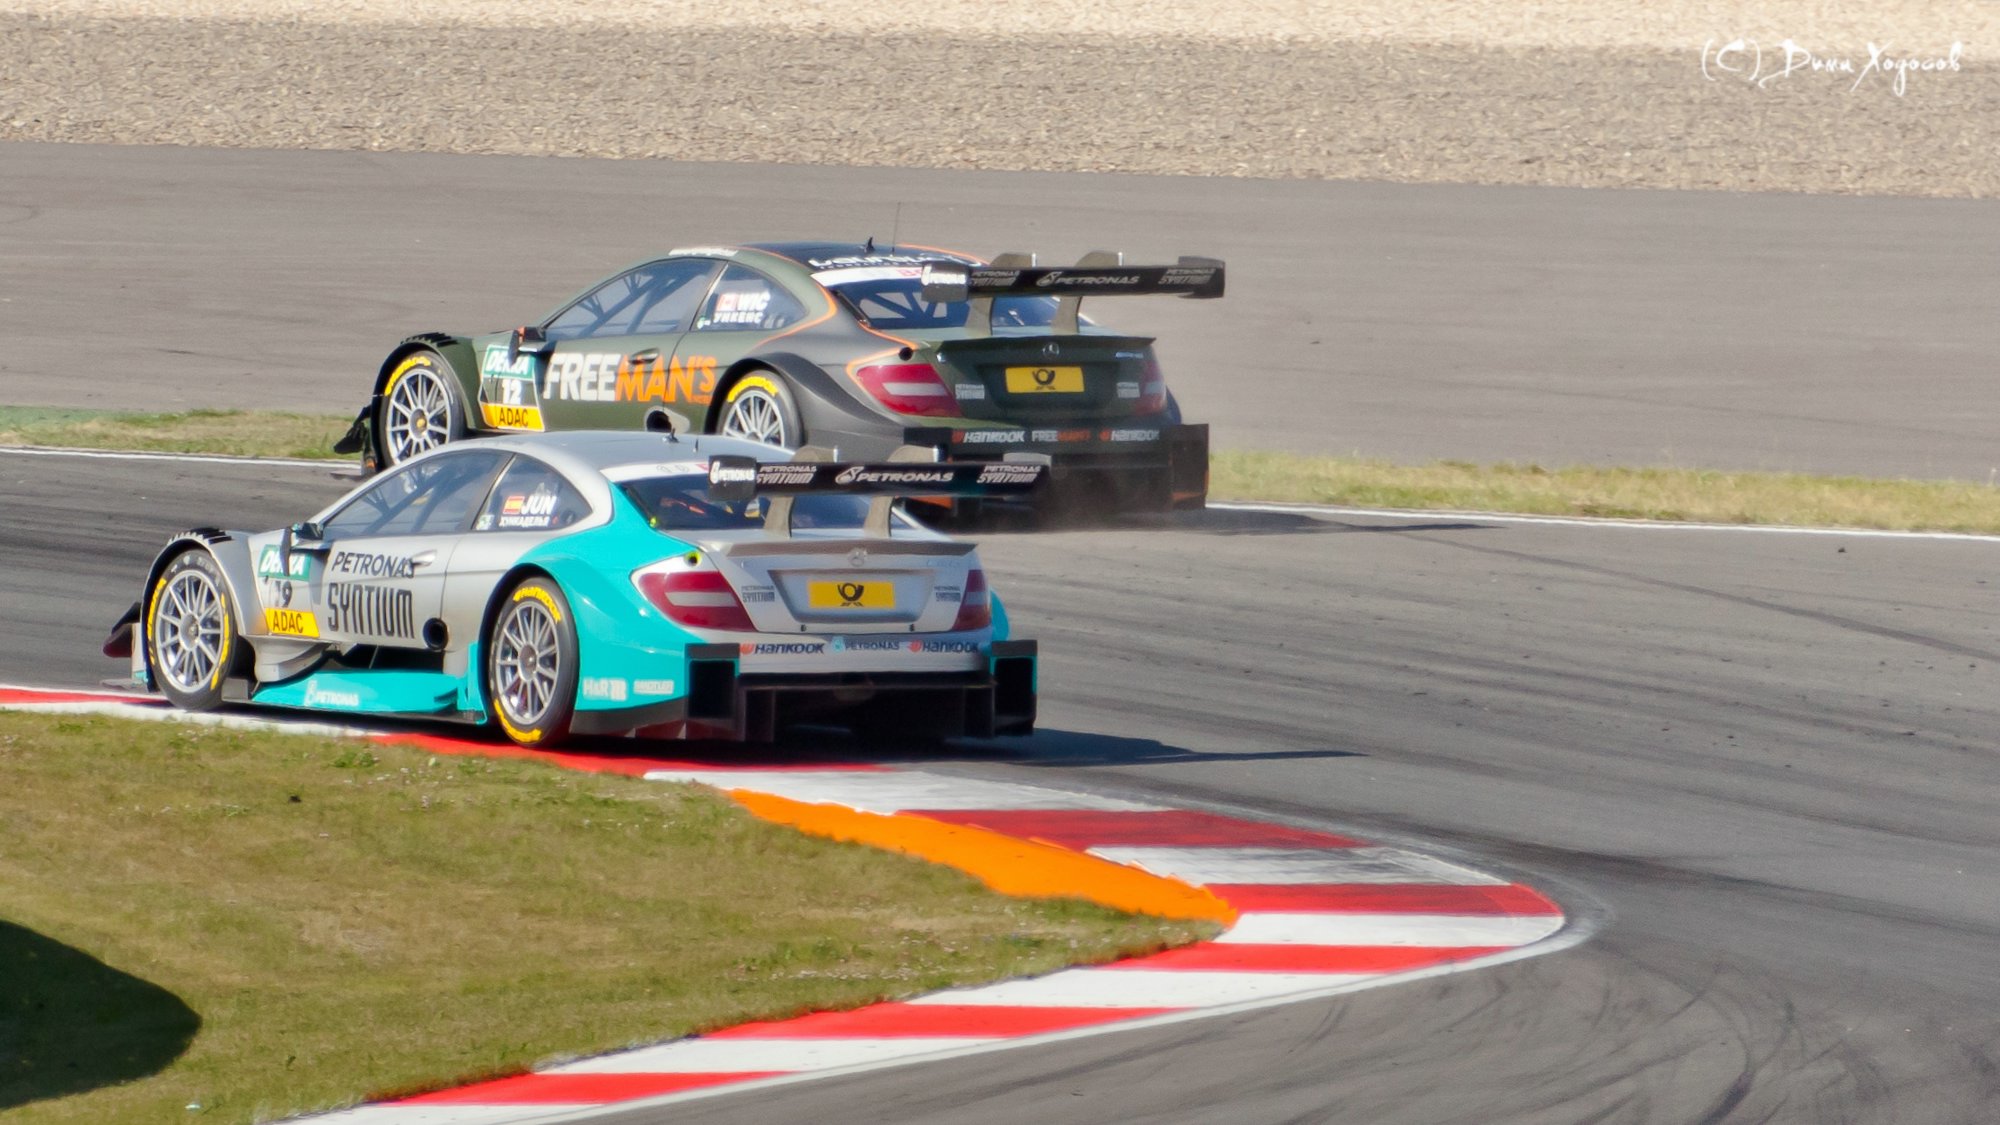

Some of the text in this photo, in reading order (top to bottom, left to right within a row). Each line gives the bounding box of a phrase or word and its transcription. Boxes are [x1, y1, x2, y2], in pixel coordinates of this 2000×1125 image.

[1055, 275, 1141, 286] PETRONAS
[543, 351, 717, 405] FREEMAN'S
[501, 379, 522, 405] 12
[499, 408, 528, 427] ADAC
[759, 465, 817, 473] PETRONAS
[857, 471, 954, 482] PETRONAS
[984, 465, 1041, 473] PETRONAS
[521, 495, 557, 515] JUN
[331, 551, 415, 579] PETRONAS
[273, 610, 304, 634] ADAC
[846, 641, 899, 651] PETRONAS
